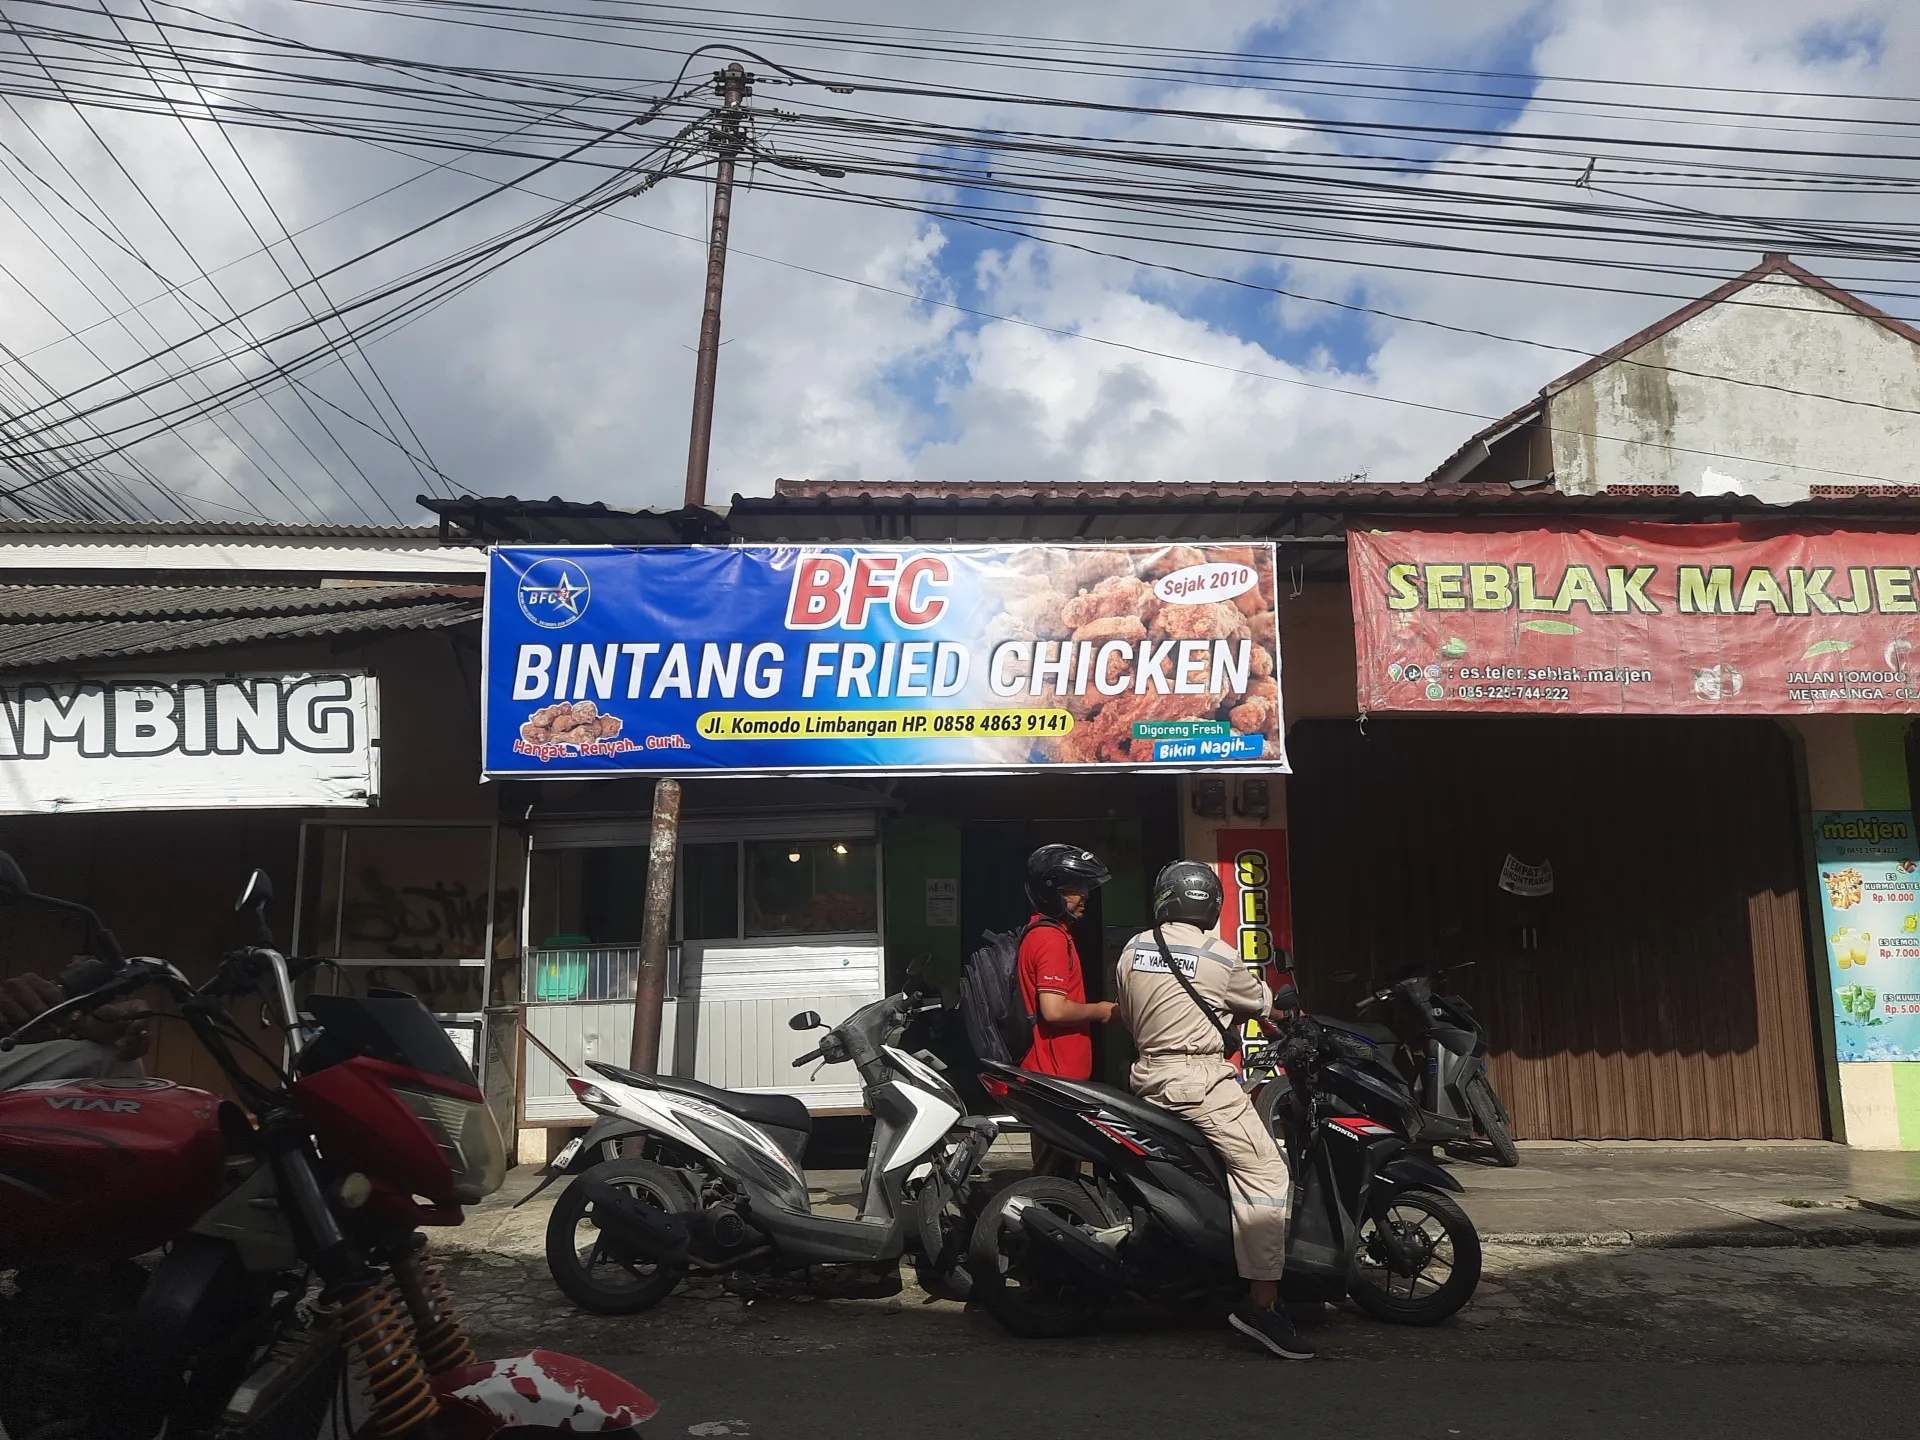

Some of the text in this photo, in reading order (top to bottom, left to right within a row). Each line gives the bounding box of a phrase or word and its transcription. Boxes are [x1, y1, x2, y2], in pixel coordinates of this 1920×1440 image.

[784, 553, 954, 631] BFC
[1164, 569, 1248, 597] Sejak 2010
[1386, 562, 1920, 616] SEBLAK MAKJE
[529, 591, 558, 605] BFC
[512, 639, 1252, 700] BINTANG FRIED CHICKEN
[1460, 665, 1653, 684] es.teler.seblak.makjen
[1788, 671, 1834, 684] JALAN
[1458, 686, 1570, 700] 085-225-744-222
[1789, 688, 1885, 701] MERTASINGA
[704, 714, 1067, 737] Jl. Komodo Limbangan HP. 0858 4863 9141
[1139, 724, 1224, 738] Digoreng Fresh
[513, 735, 691, 762] Hangat... Renyah... Gurih..
[1159, 737, 1256, 760] Bikin Nagih...
[1822, 817, 1907, 844] makjen
[1506, 860, 1540, 877] TEMPAT
[1896, 882, 1920, 890] LATTE
[1872, 893, 1915, 903] Rp. 10.000
[1880, 949, 1920, 959] Rp. 7.000
[1235, 850, 1280, 1082] SEB
[1885, 1005, 1899, 1015] Rp.
[44, 1097, 141, 1114] VIAR
[1328, 1122, 1360, 1141] HONDA
